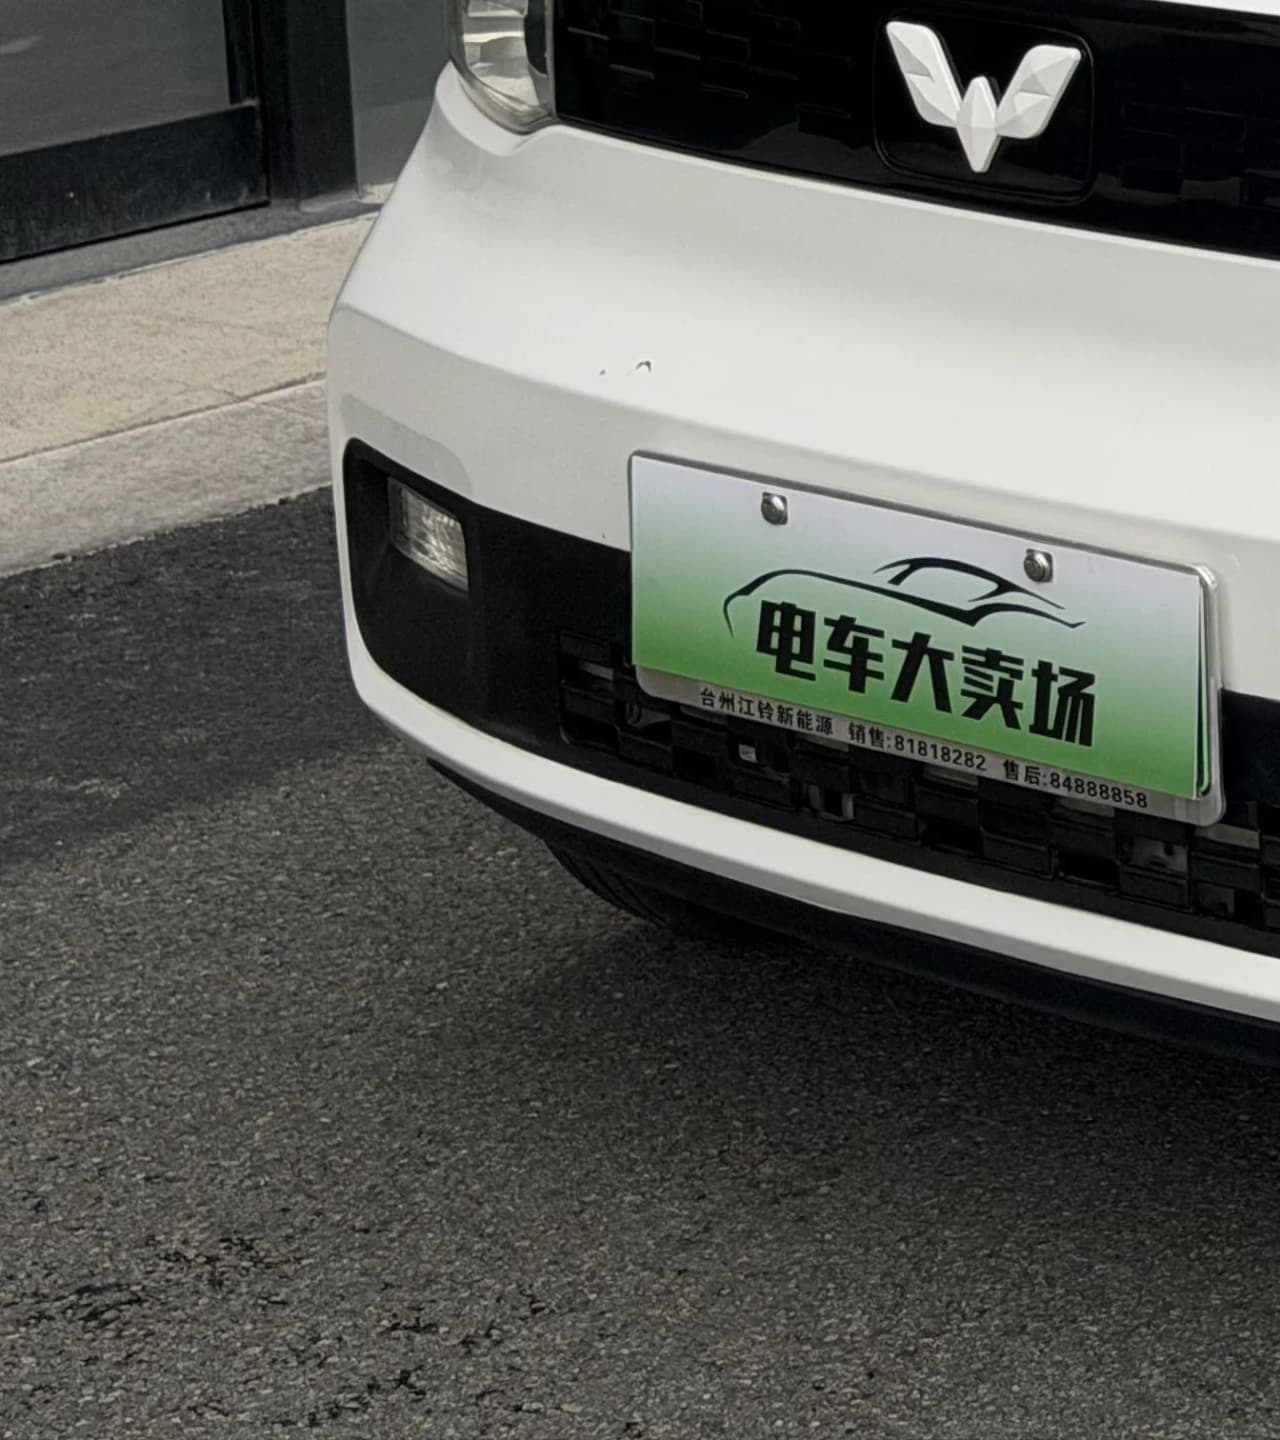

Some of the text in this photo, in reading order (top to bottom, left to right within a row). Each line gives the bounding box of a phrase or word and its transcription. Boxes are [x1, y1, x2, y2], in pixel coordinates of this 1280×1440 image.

[699, 686, 833, 736] 台州江铃新能源
[756, 601, 1097, 747] 电车大卖场
